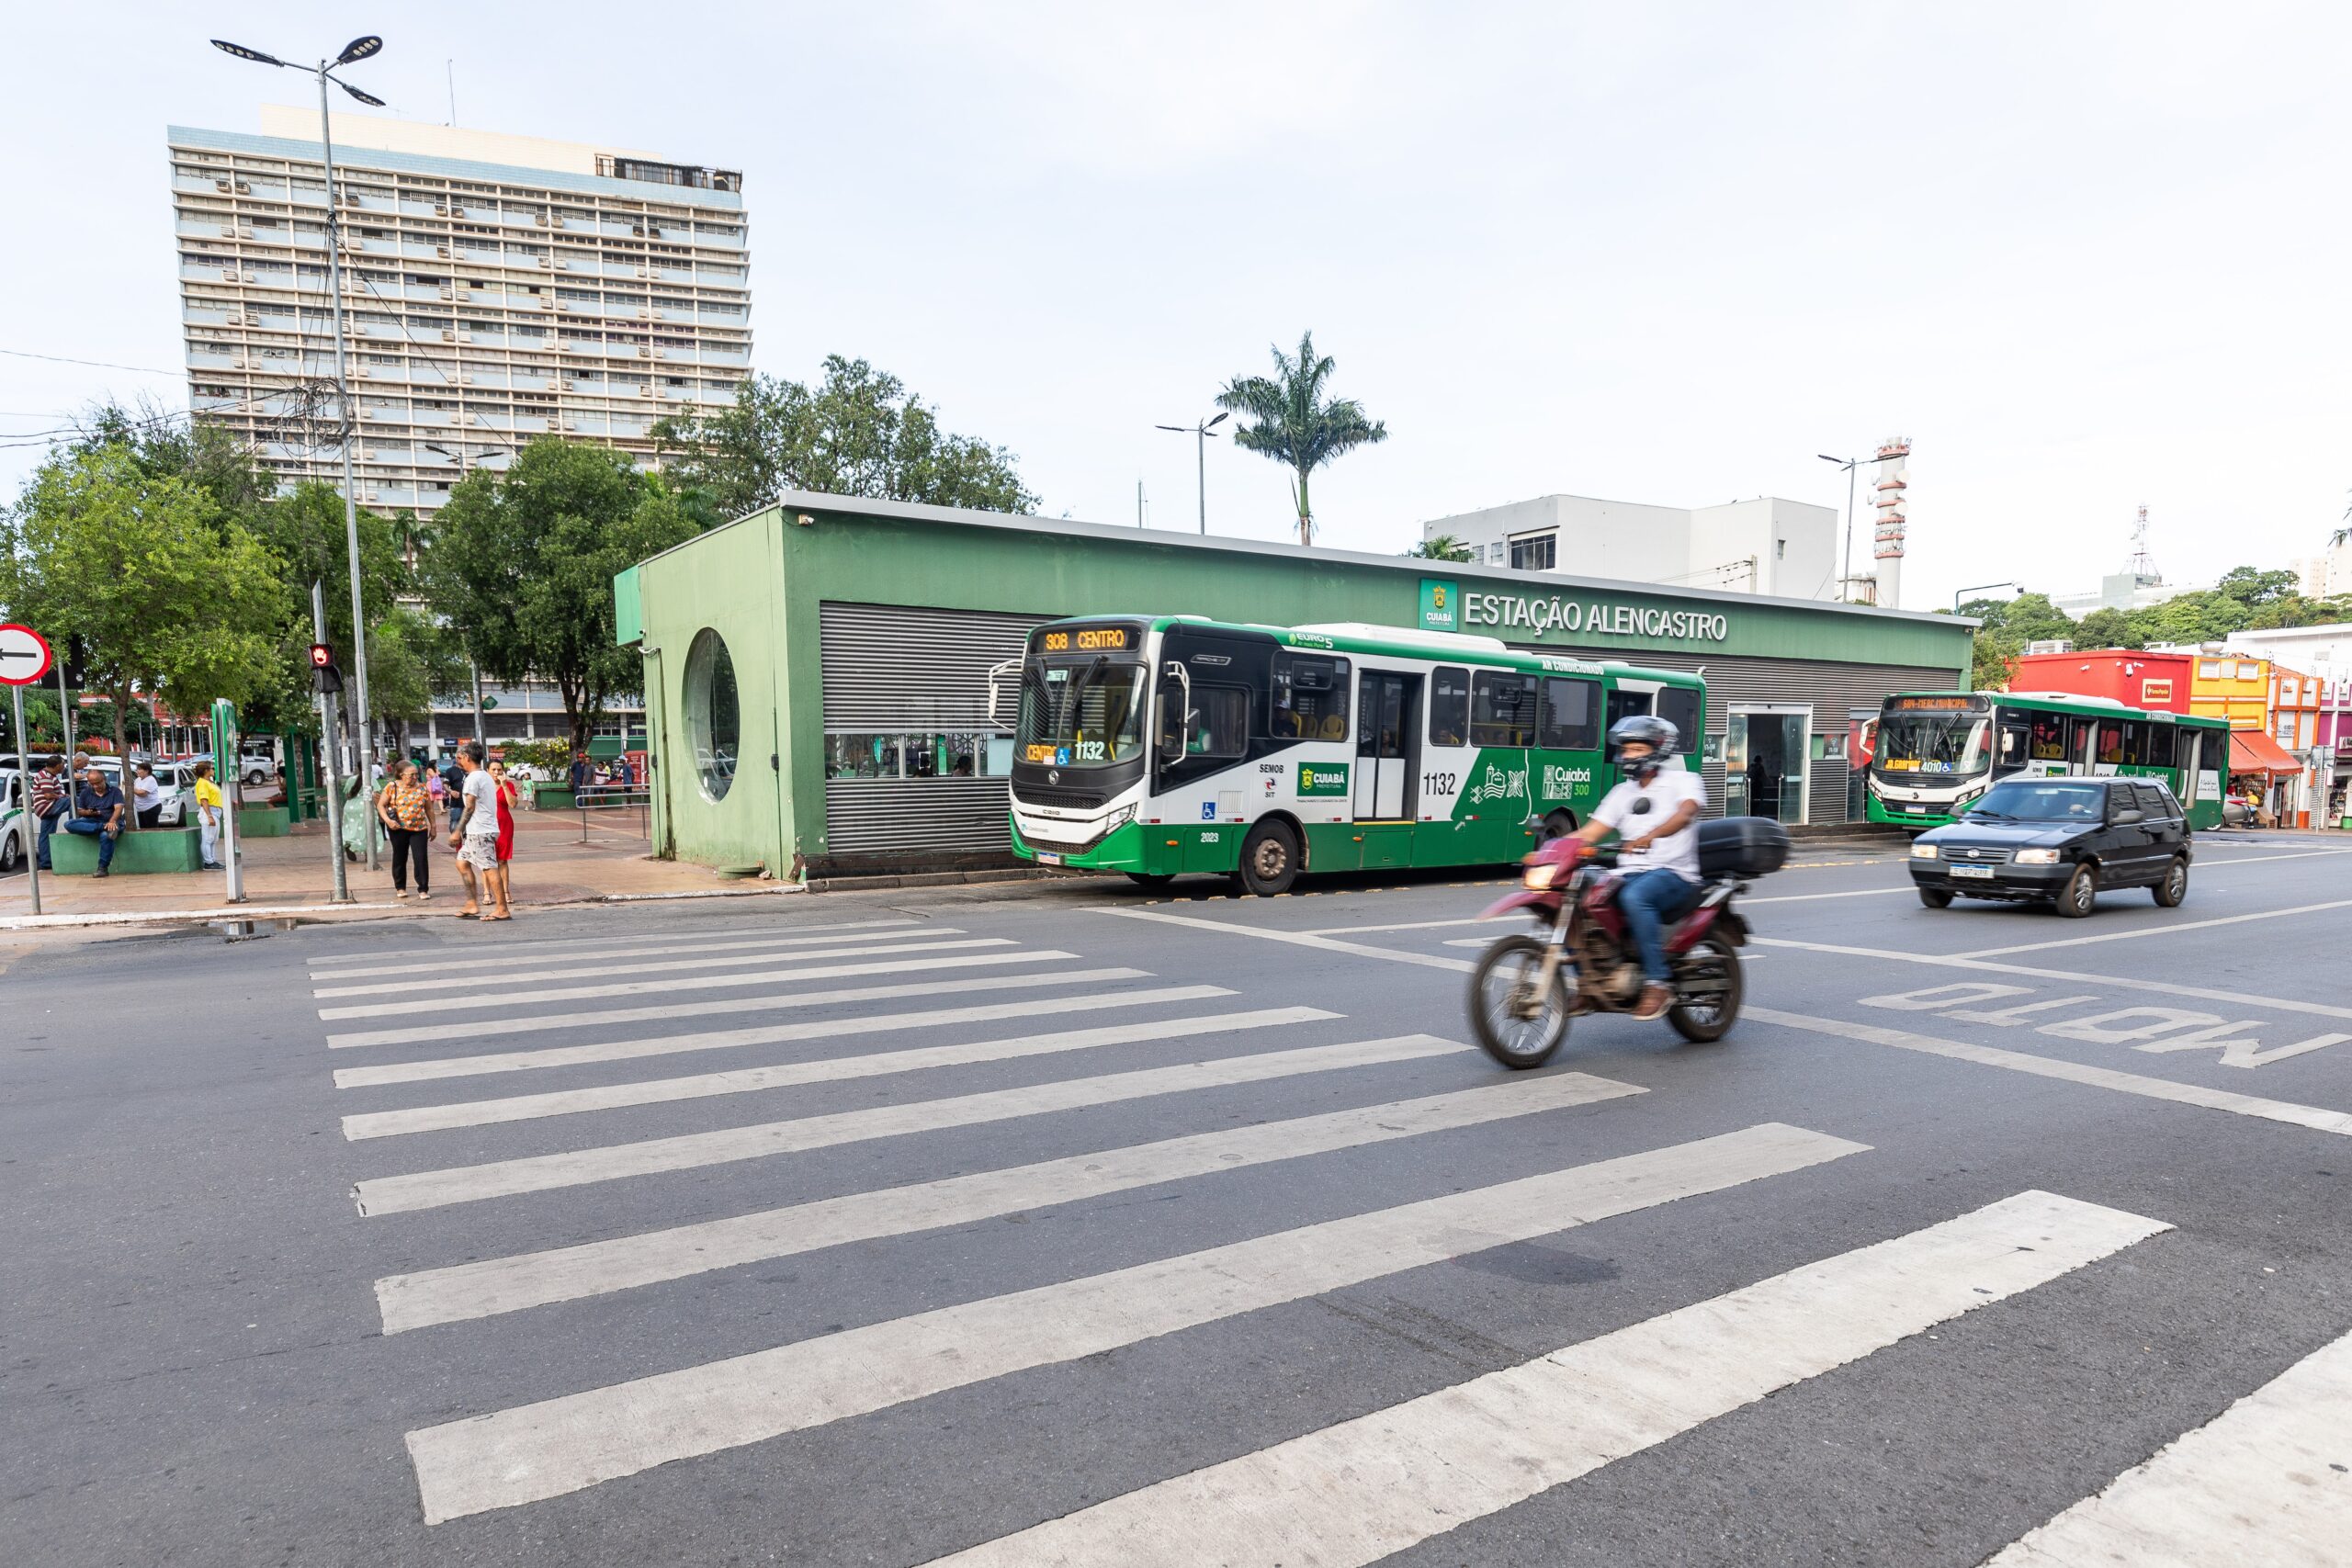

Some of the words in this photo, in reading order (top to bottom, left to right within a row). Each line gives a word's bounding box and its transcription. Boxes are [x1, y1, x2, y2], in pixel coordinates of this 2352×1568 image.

[1426, 612, 1453, 622] CUIABÁ
[1464, 593, 1582, 637] ESTAÇÃO
[1586, 604, 1727, 641] ALENCASTRO
[1077, 629, 1125, 649] CENTRO
[1296, 633, 1325, 642] EURO
[1325, 637, 1334, 649] 5
[1554, 661, 1605, 675] CONDICIONADO
[1075, 740, 1105, 761] 1132
[1259, 764, 1284, 773] SEMOB
[1921, 761, 1942, 773] 4010
[1313, 771, 1345, 784] CUIABÁ
[1555, 767, 1590, 783] Cuiabá
[1424, 773, 1456, 795] 1132
[1574, 784, 1589, 795] 300
[1200, 831, 1219, 843] 2023
